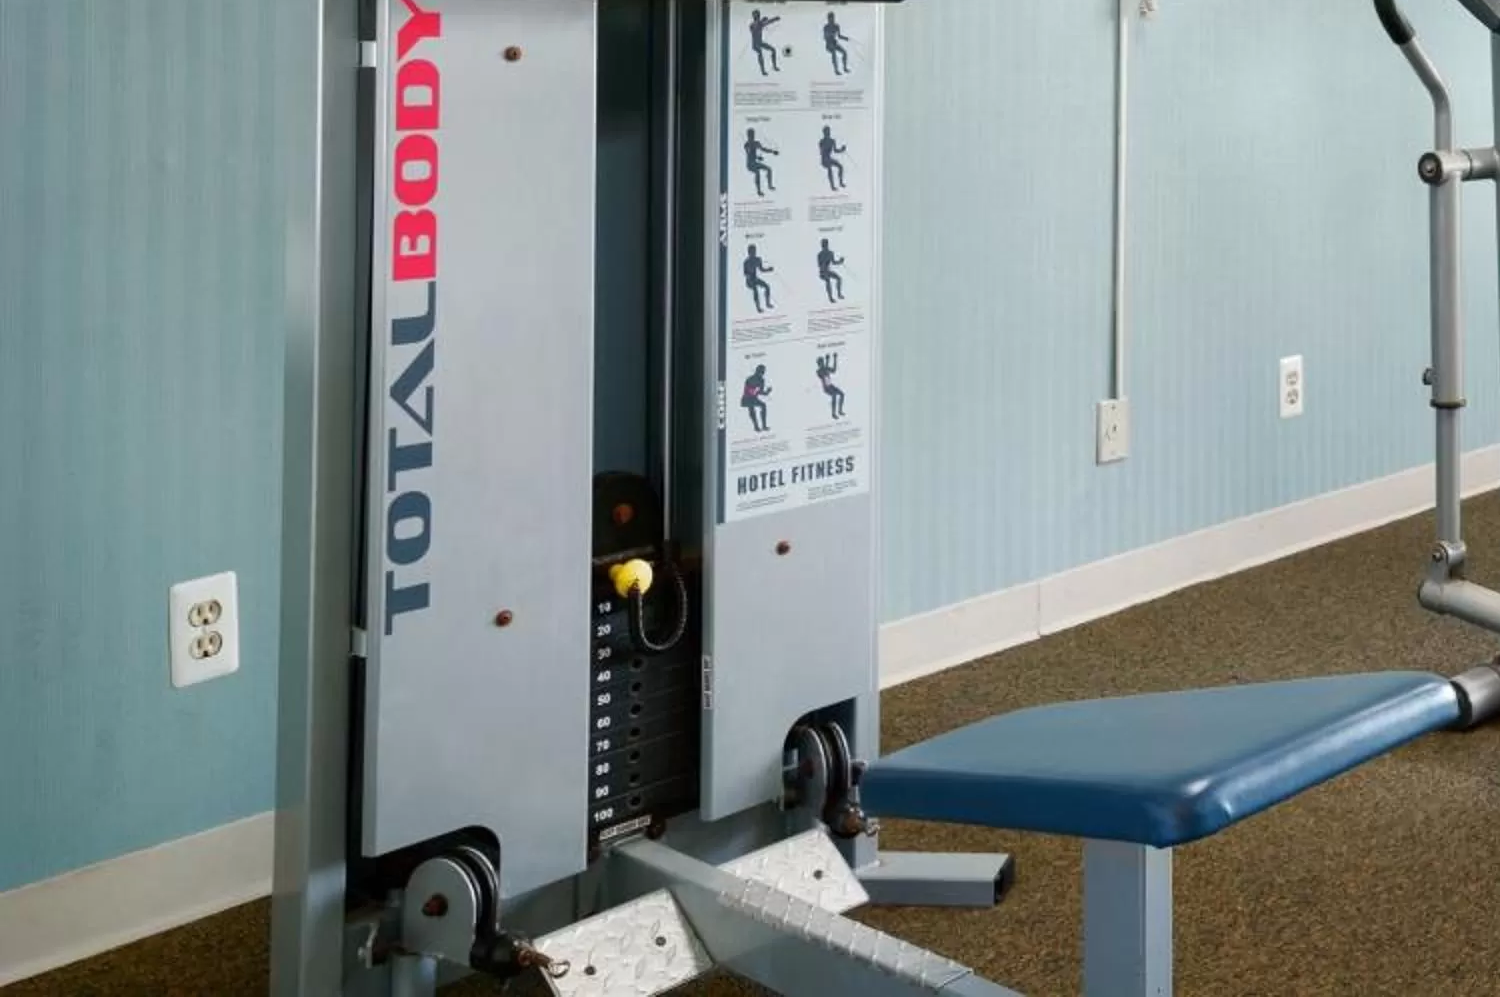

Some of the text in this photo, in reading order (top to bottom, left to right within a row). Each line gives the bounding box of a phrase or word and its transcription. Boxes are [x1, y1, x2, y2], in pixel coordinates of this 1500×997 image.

[737, 469, 785, 496] HOTEL
[791, 455, 855, 484] FITNESS
[598, 601, 612, 614] 10
[597, 624, 611, 637] 20
[597, 646, 612, 660] 30
[597, 670, 611, 682] 40
[597, 692, 611, 706] 50
[597, 716, 611, 728] 60
[596, 739, 610, 752] 70
[596, 762, 610, 776] 80
[596, 785, 609, 798] 90
[594, 807, 613, 822] 100
